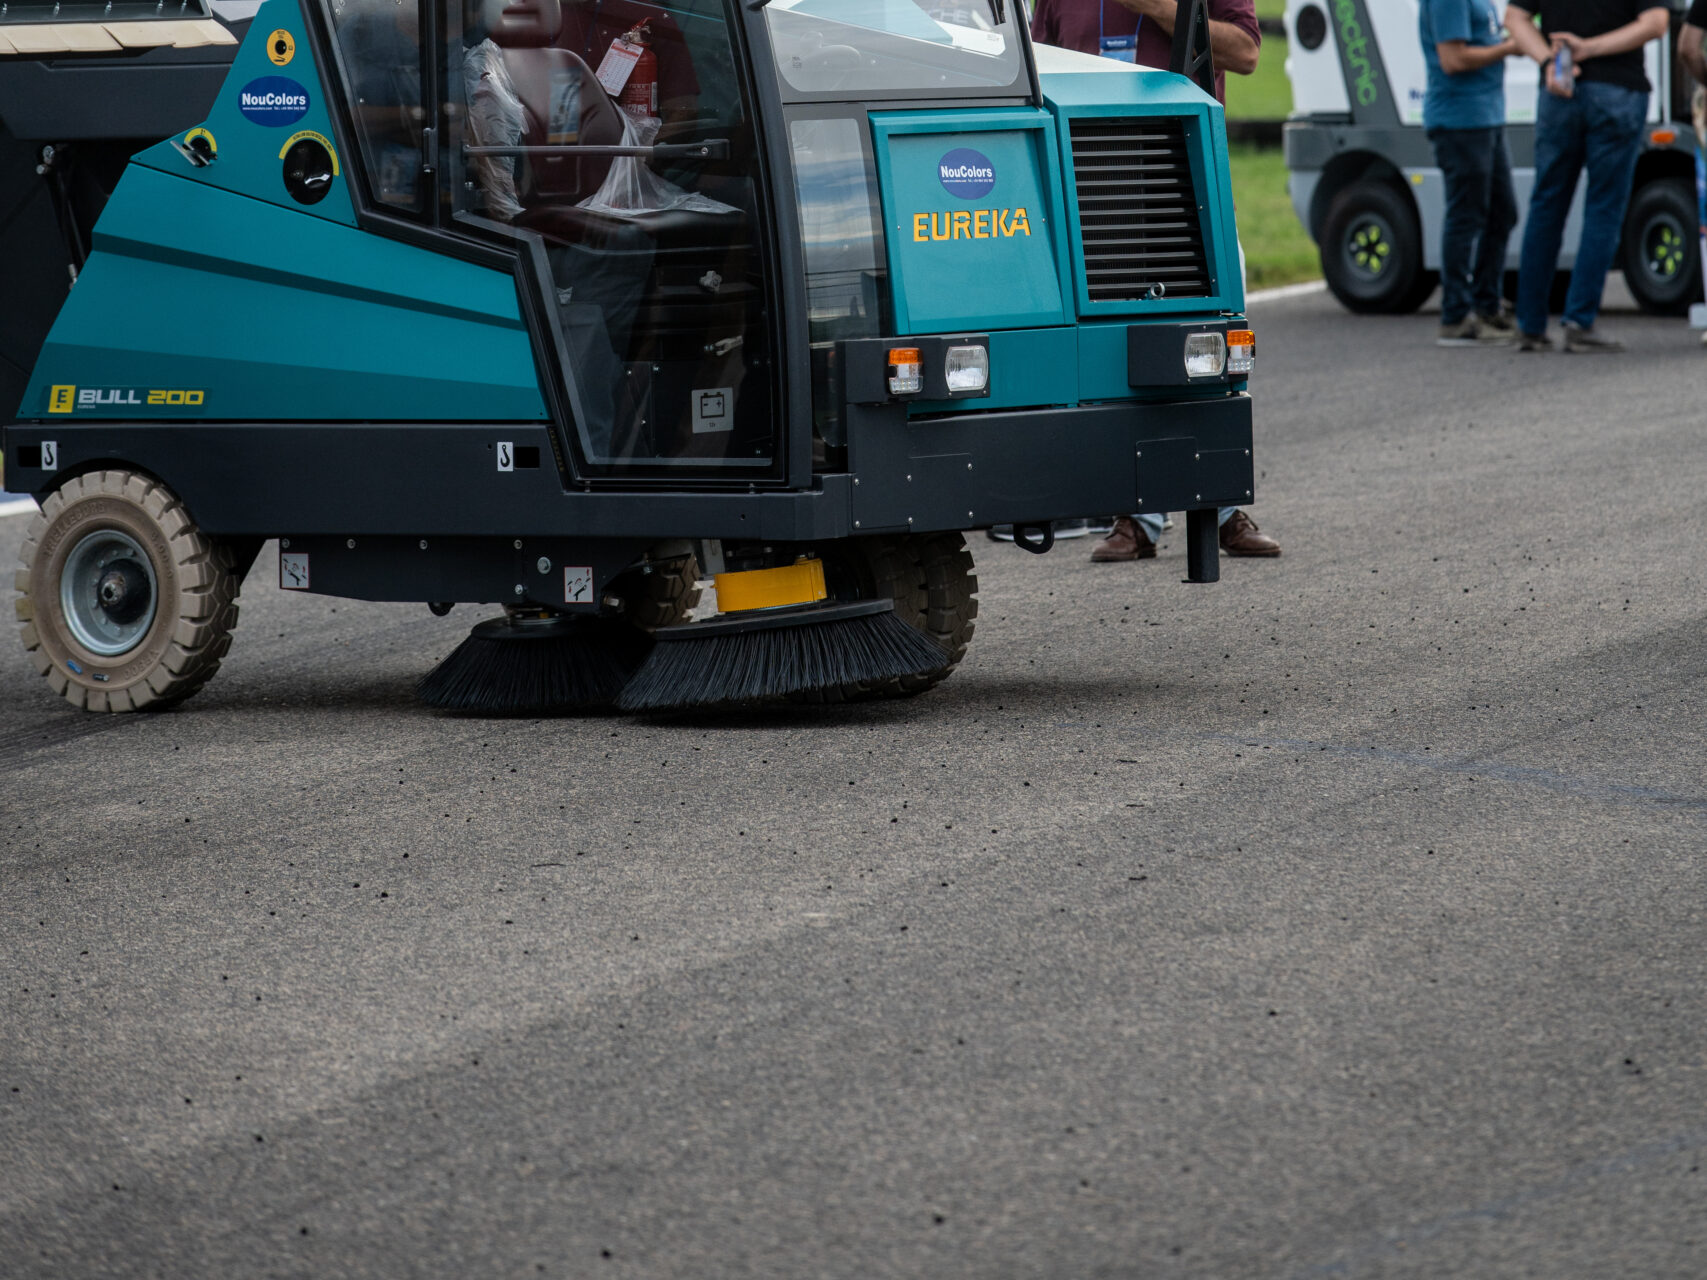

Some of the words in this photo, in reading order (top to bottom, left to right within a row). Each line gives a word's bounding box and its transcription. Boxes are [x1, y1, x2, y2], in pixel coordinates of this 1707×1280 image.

[242, 92, 307, 106] NouColors
[940, 165, 993, 179] NouColors
[913, 207, 1032, 243] EUREKA
[78, 389, 142, 405] BULL
[147, 389, 205, 405] 200
